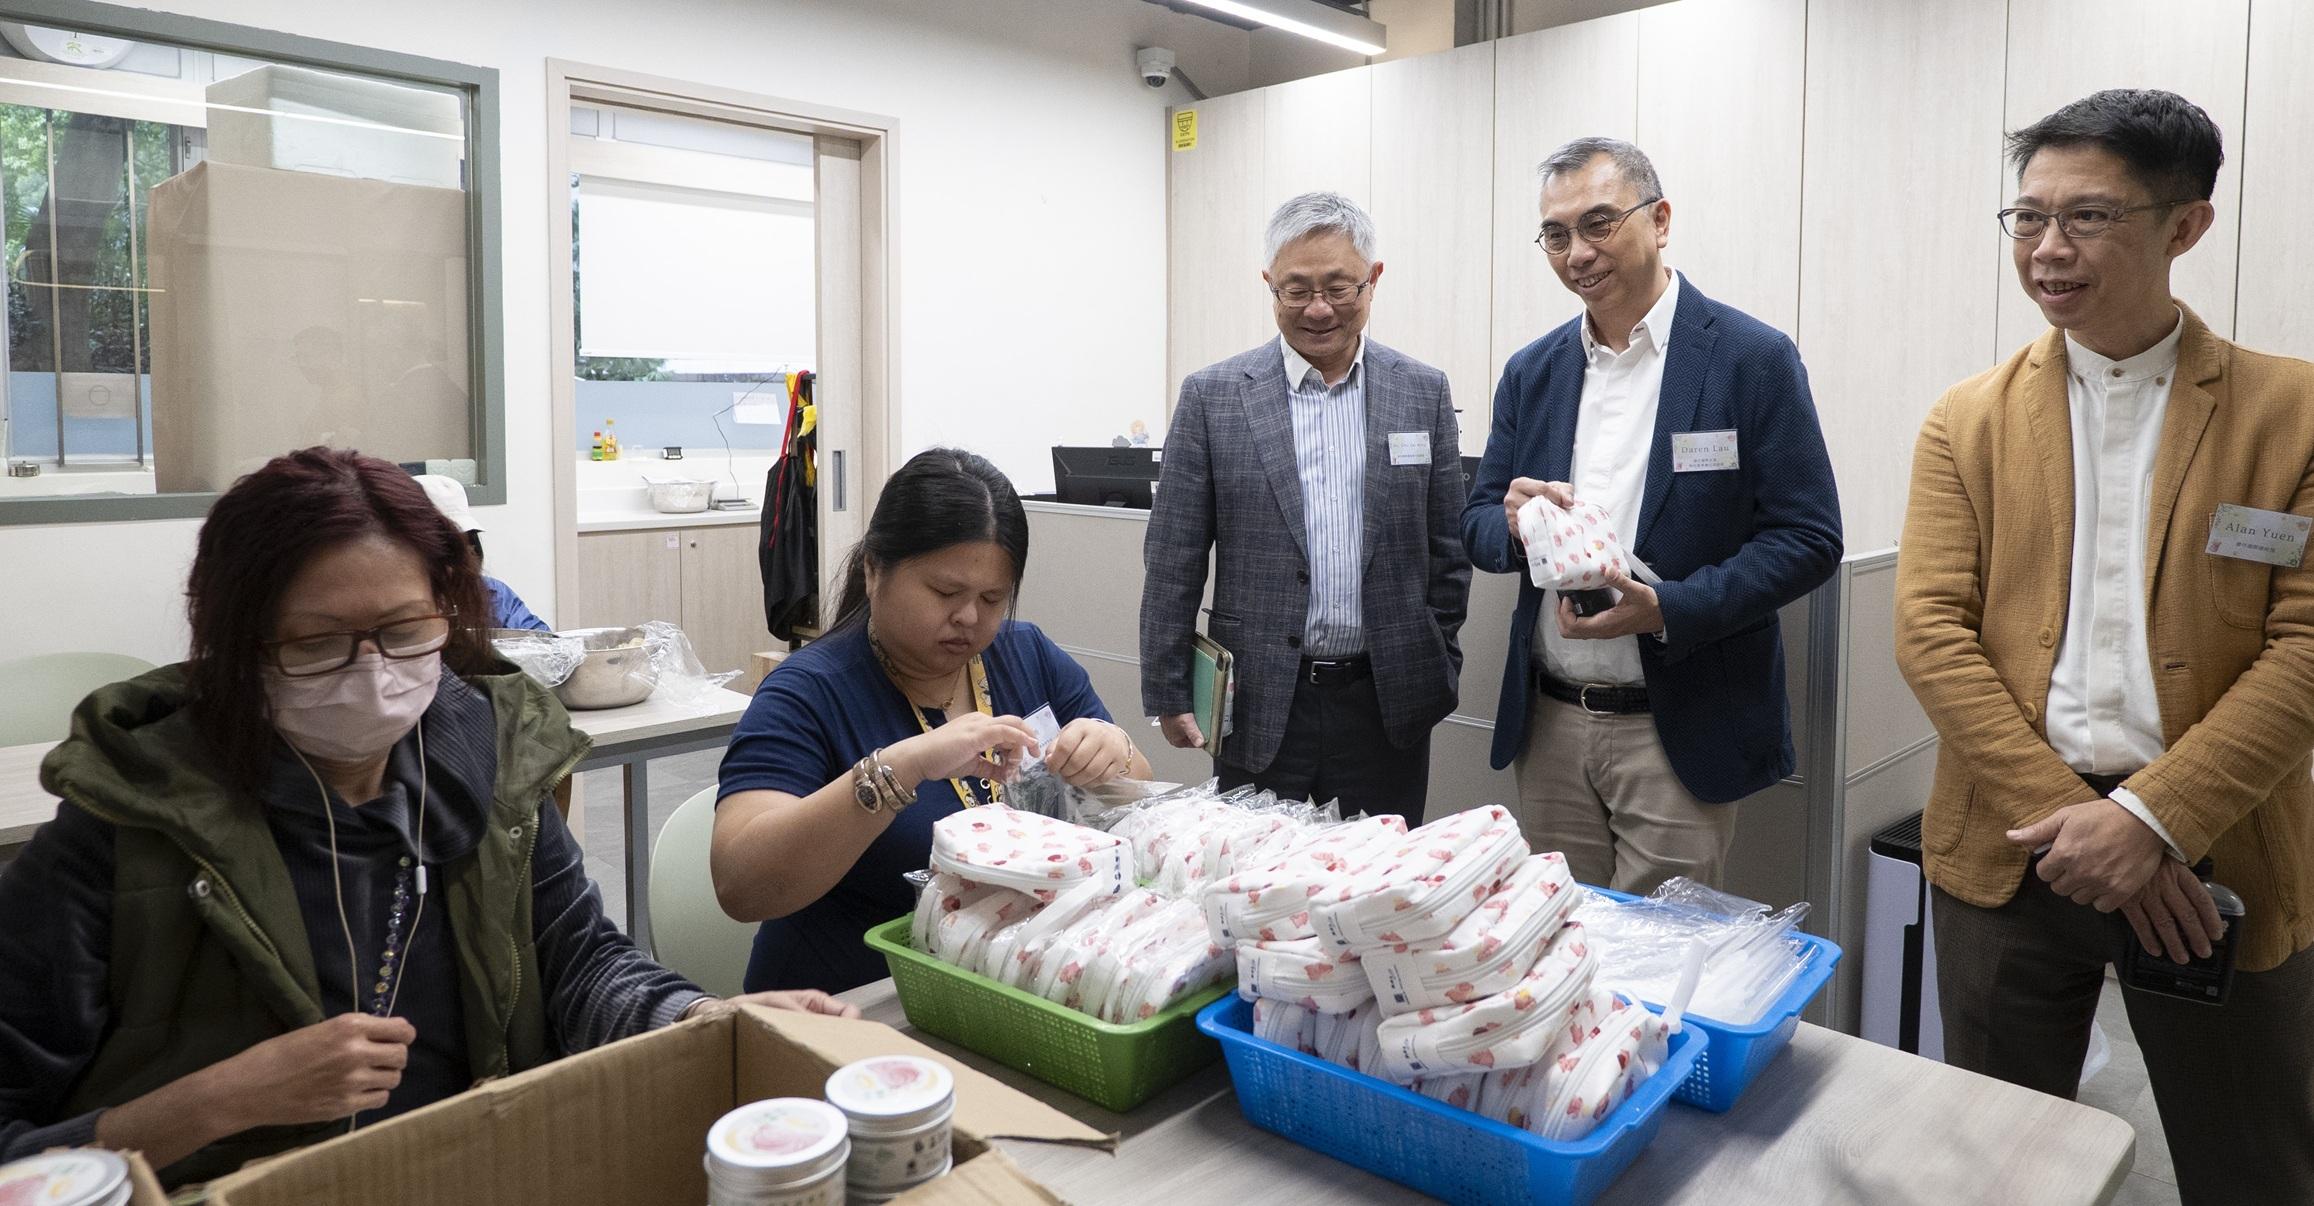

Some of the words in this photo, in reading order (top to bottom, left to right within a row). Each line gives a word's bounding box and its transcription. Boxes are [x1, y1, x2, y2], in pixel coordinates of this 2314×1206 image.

[1681, 446, 1709, 454] Daren
[2225, 522, 2256, 536] Alan
[2263, 527, 2295, 542] Yuen
